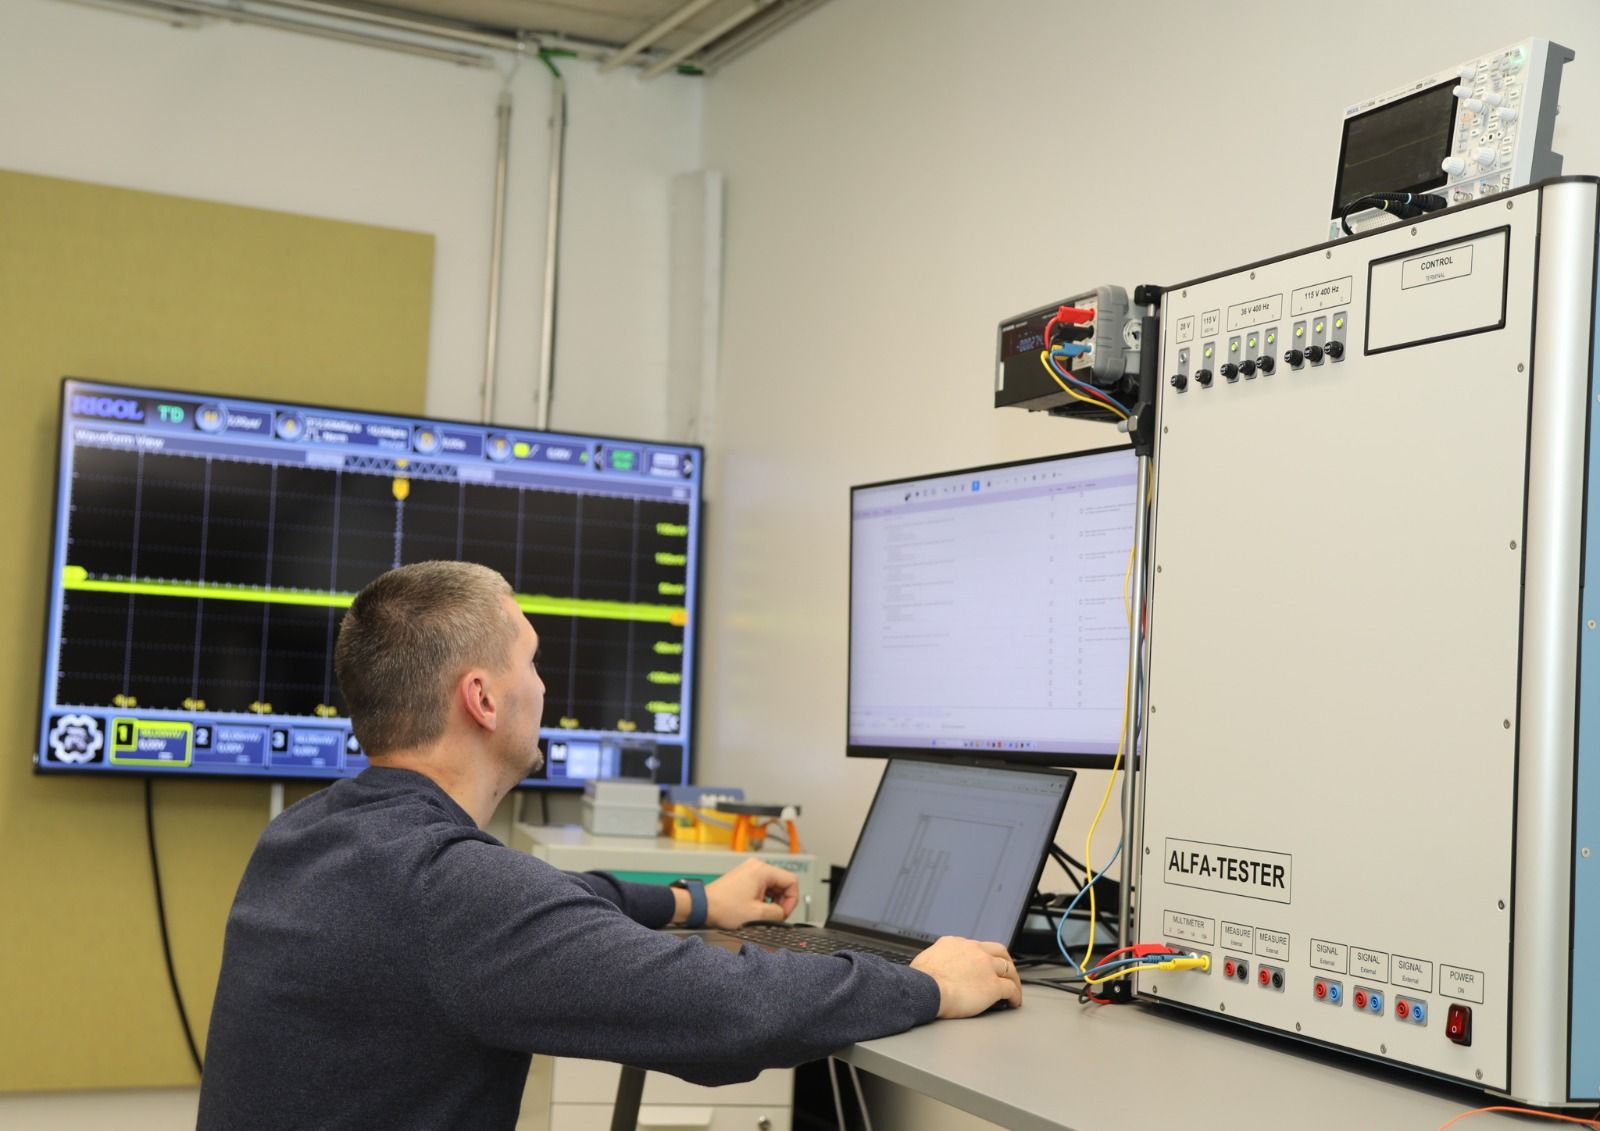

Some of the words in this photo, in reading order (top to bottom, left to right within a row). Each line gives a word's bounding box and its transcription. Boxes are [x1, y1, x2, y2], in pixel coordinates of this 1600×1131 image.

[1421, 256, 1453, 271] CONTROL
[1305, 291, 1314, 299] 115
[1321, 287, 1330, 296] 400
[1252, 304, 1262, 312] 400
[1203, 316, 1212, 325] 115
[72, 395, 145, 420] RIGOL
[74, 429, 135, 446] Waveform
[135, 434, 165, 449] View
[118, 725, 128, 742] 1
[196, 727, 209, 745] 2
[272, 731, 285, 748] 3
[1168, 850, 1285, 889] ALFA-TESTER
[1172, 915, 1205, 929] MULTIMETER
[1225, 925, 1251, 938] MEASURE
[1259, 932, 1288, 946] MEASURE
[1316, 943, 1338, 956] SIGNAL
[1320, 957, 1335, 966] External
[1357, 952, 1380, 965] SIGNAL
[1360, 966, 1376, 975] External
[1398, 960, 1423, 973] SIGNAL
[1402, 975, 1419, 984] External
[1449, 971, 1475, 983] POWER
